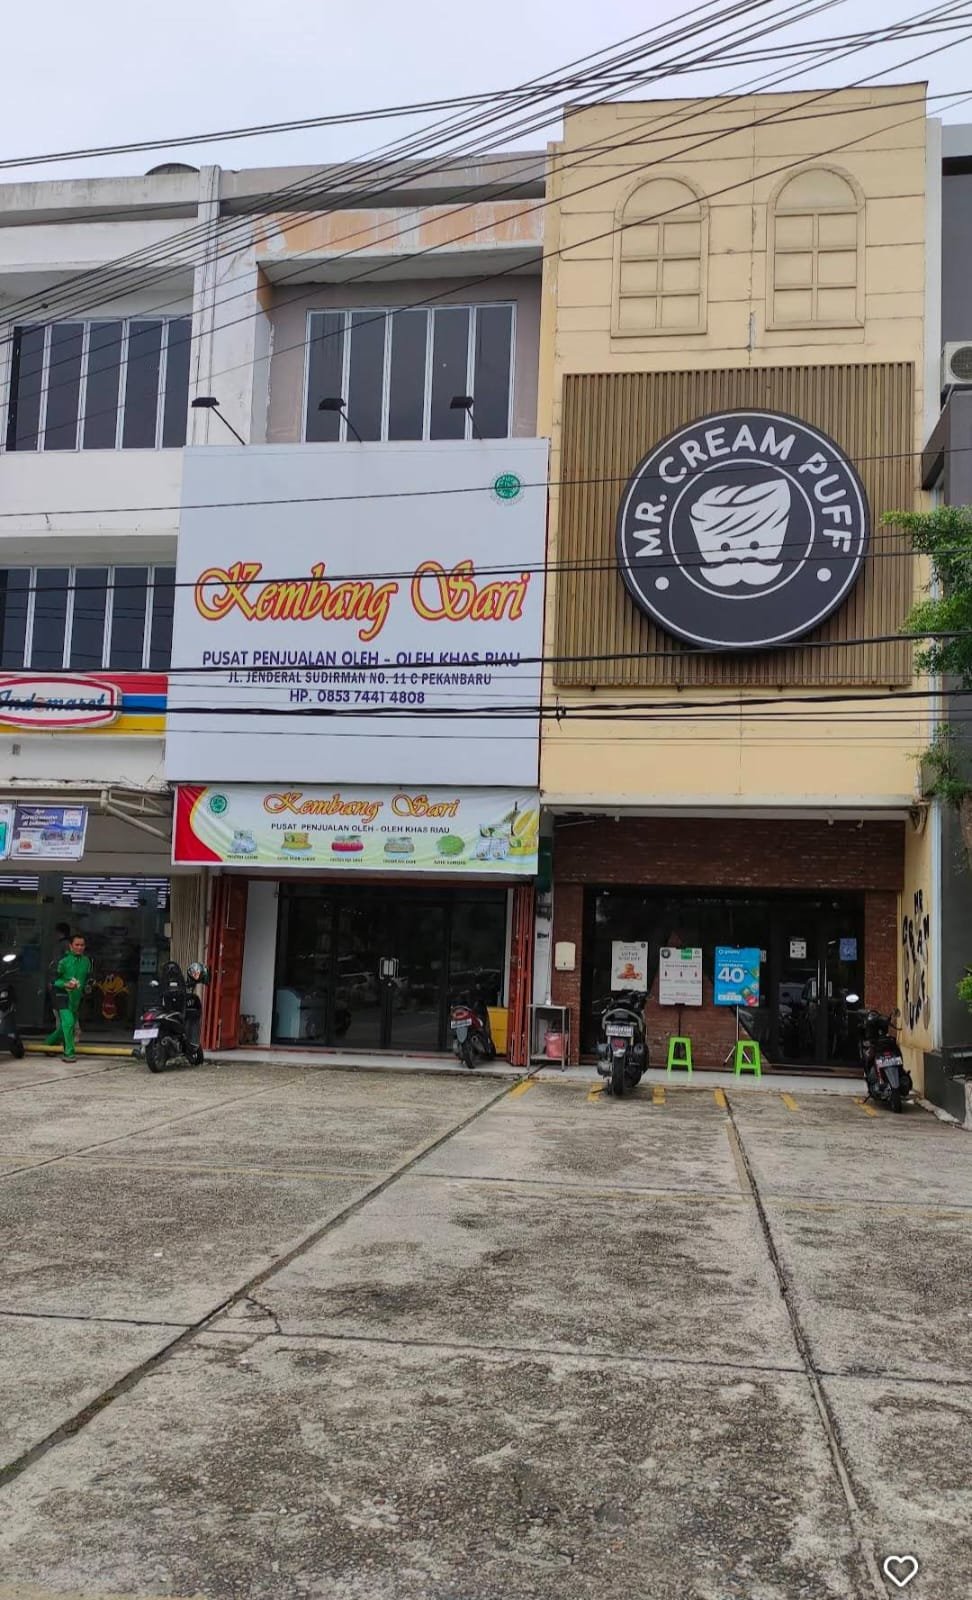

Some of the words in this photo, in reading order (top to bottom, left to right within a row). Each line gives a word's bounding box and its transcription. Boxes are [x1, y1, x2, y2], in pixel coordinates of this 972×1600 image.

[632, 494, 668, 557] MR.
[658, 424, 796, 484] CREAM
[798, 452, 852, 553] PUFF
[194, 561, 398, 642] Kembang
[410, 560, 531, 621] Sari
[202, 651, 248, 666] PUSAT
[253, 651, 337, 667] PENJUALAN
[342, 652, 379, 667] OLEH
[396, 652, 434, 667] OLEH
[440, 652, 479, 666] KHAS
[485, 652, 521, 667] RIAU
[228, 672, 243, 684] JL.
[246, 672, 302, 684] JENDERAL
[305, 672, 366, 684] SUDIRMAN
[369, 673, 389, 685] NO.
[393, 673, 406, 685] 11
[410, 673, 418, 685] C
[422, 673, 492, 685] PEKANBARU
[290, 690, 313, 703] HP.
[317, 690, 350, 703] 0853
[354, 690, 384, 704] 7441
[389, 691, 425, 704] 4808
[263, 792, 384, 824] Kembang
[391, 793, 460, 817] Sari
[272, 823, 297, 831] PUSAT
[301, 824, 350, 832] PENJUALAN
[351, 825, 374, 833] OLEH
[380, 825, 403, 833] OLEH
[405, 825, 428, 833] KHAS
[430, 826, 450, 834] RIAU
[717, 967, 745, 983] 40
